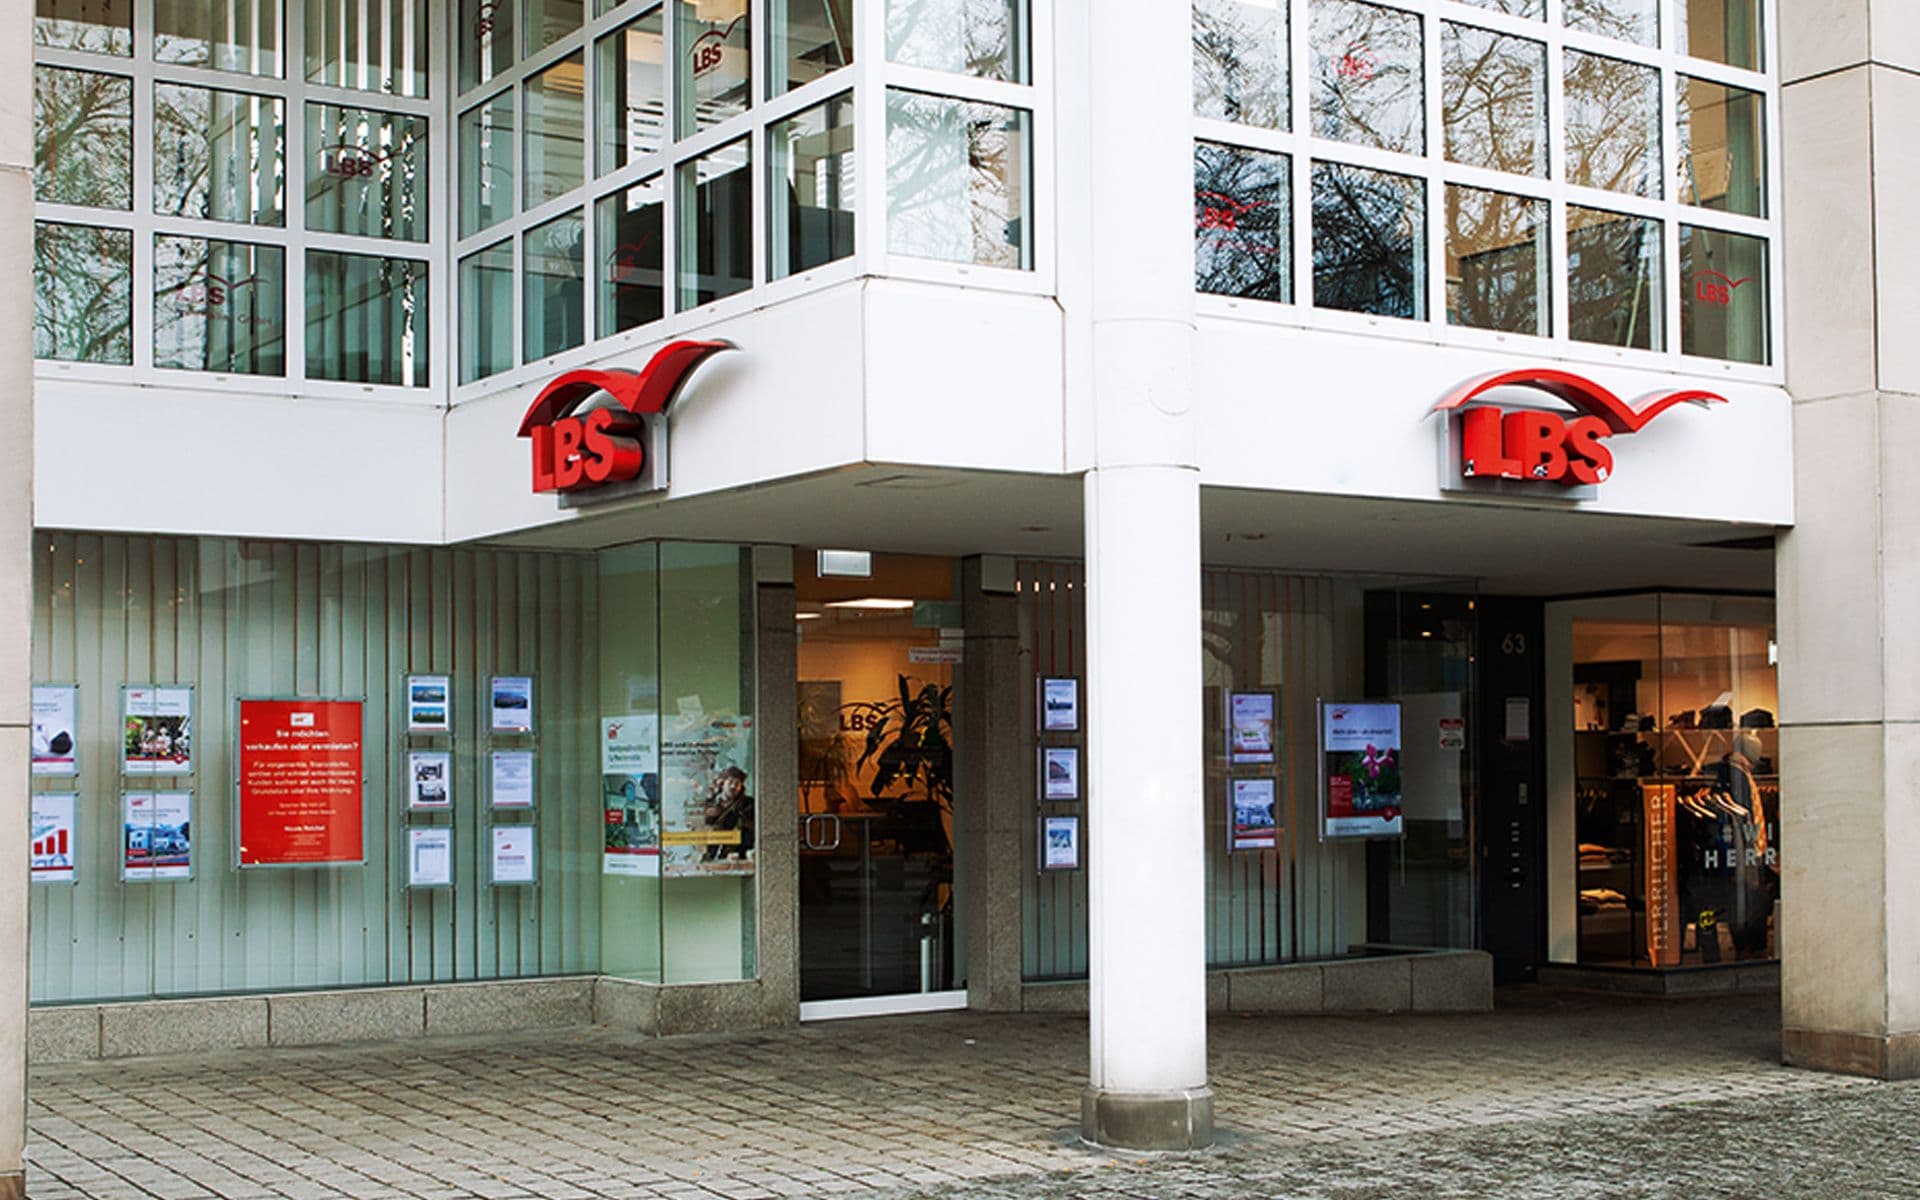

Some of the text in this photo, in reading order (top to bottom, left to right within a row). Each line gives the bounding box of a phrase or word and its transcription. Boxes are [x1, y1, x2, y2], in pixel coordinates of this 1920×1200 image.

[694, 42, 722, 73] LBS
[328, 155, 374, 177] LBS
[1696, 280, 1730, 304] LBS
[531, 407, 635, 494] LBS
[1463, 405, 1613, 485] LBS
[1501, 631, 1526, 654] 63
[839, 714, 879, 732] LBS
[1705, 848, 1776, 870] HERR
